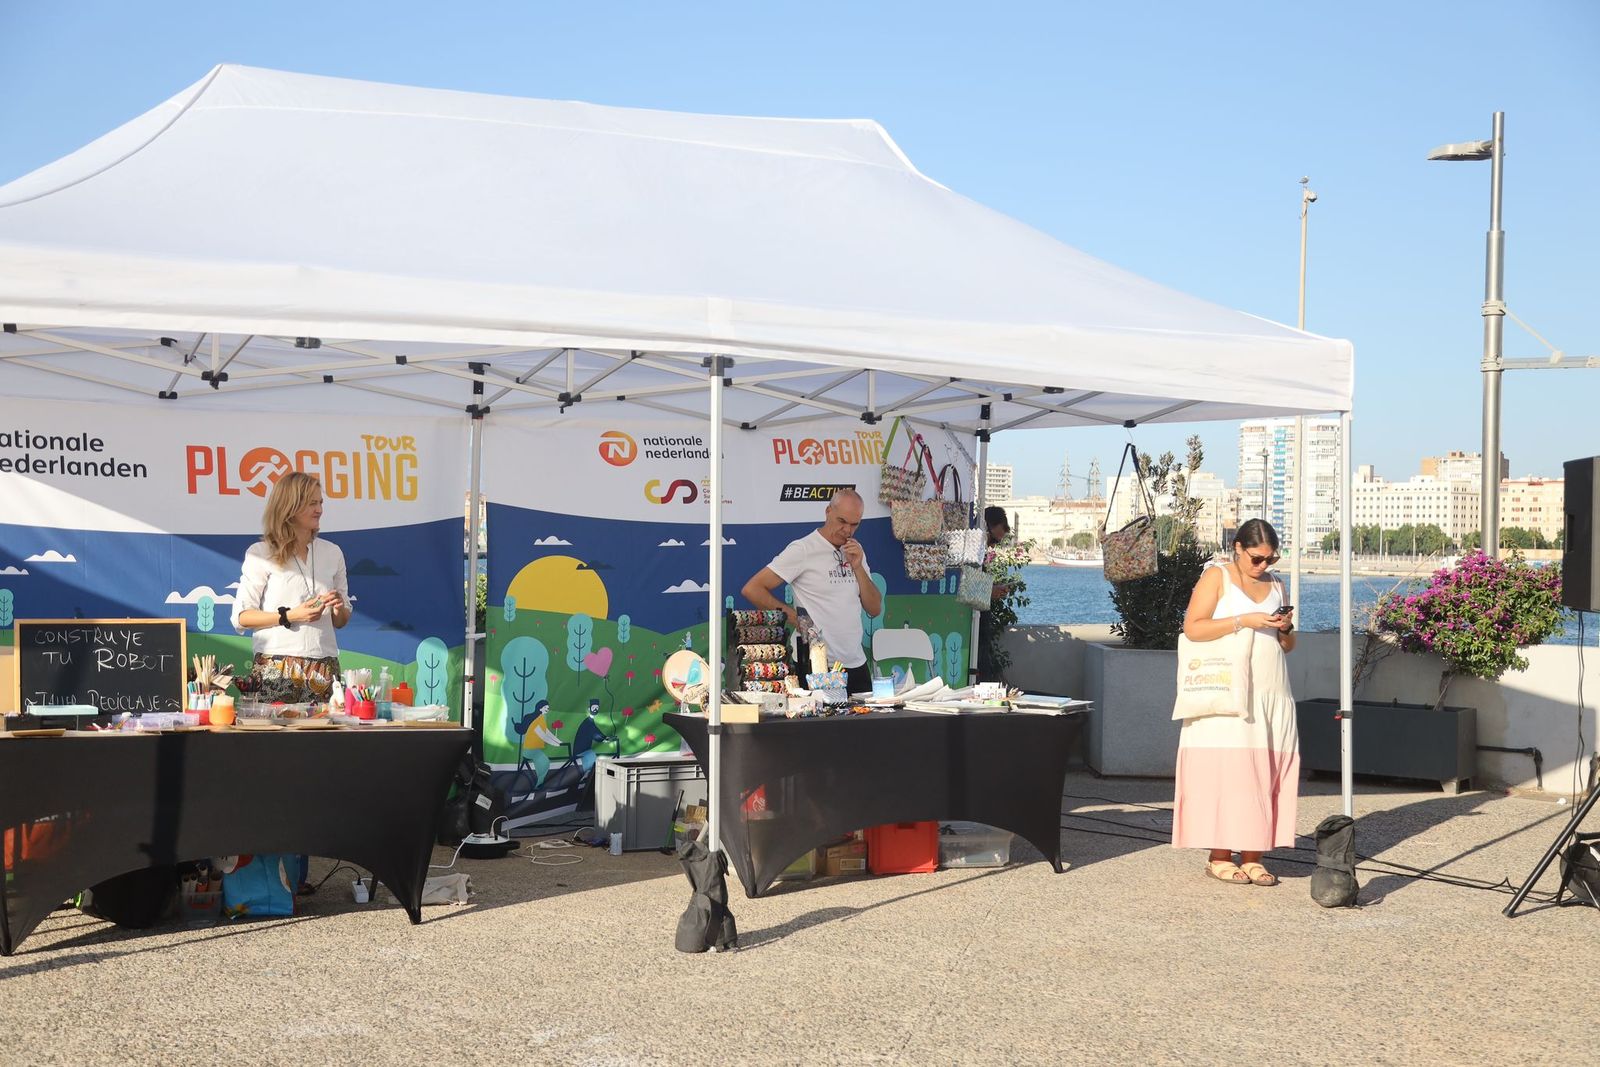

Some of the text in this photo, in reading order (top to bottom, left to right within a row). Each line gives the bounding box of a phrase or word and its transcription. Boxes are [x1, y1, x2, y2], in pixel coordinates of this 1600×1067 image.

[361, 434, 417, 452] TOUR
[643, 436, 703, 446] nationale
[855, 431, 882, 439] TOUR
[645, 448, 724, 459] nederland
[772, 438, 885, 465] PLOGGING
[35, 627, 144, 650] CONSTRUYE
[42, 651, 73, 665] TU
[94, 648, 174, 672] ROBOT
